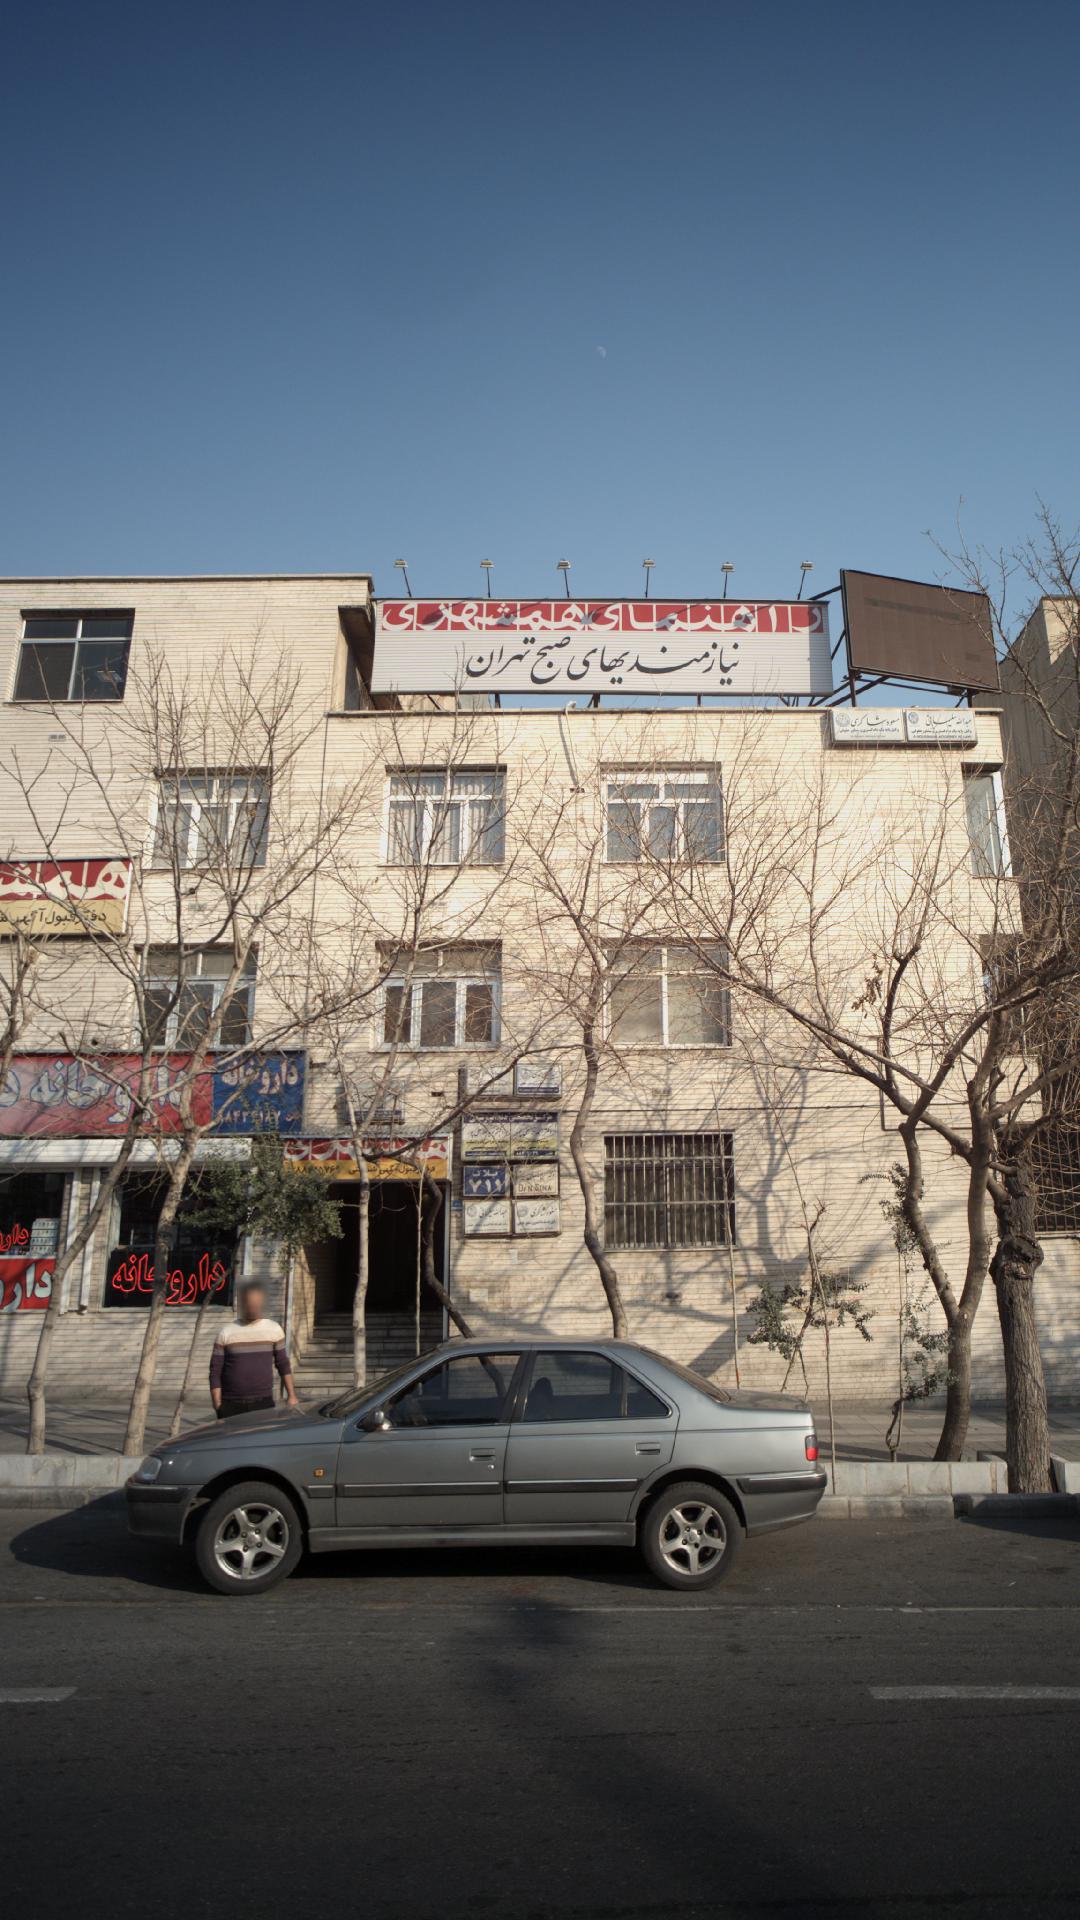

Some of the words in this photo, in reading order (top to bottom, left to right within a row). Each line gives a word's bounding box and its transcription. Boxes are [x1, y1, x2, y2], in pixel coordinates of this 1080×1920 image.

[382, 602, 586, 632] همشهری
[587, 603, 824, 633] راهنمای
[466, 636, 536, 678] تهران
[530, 636, 572, 685] صبح
